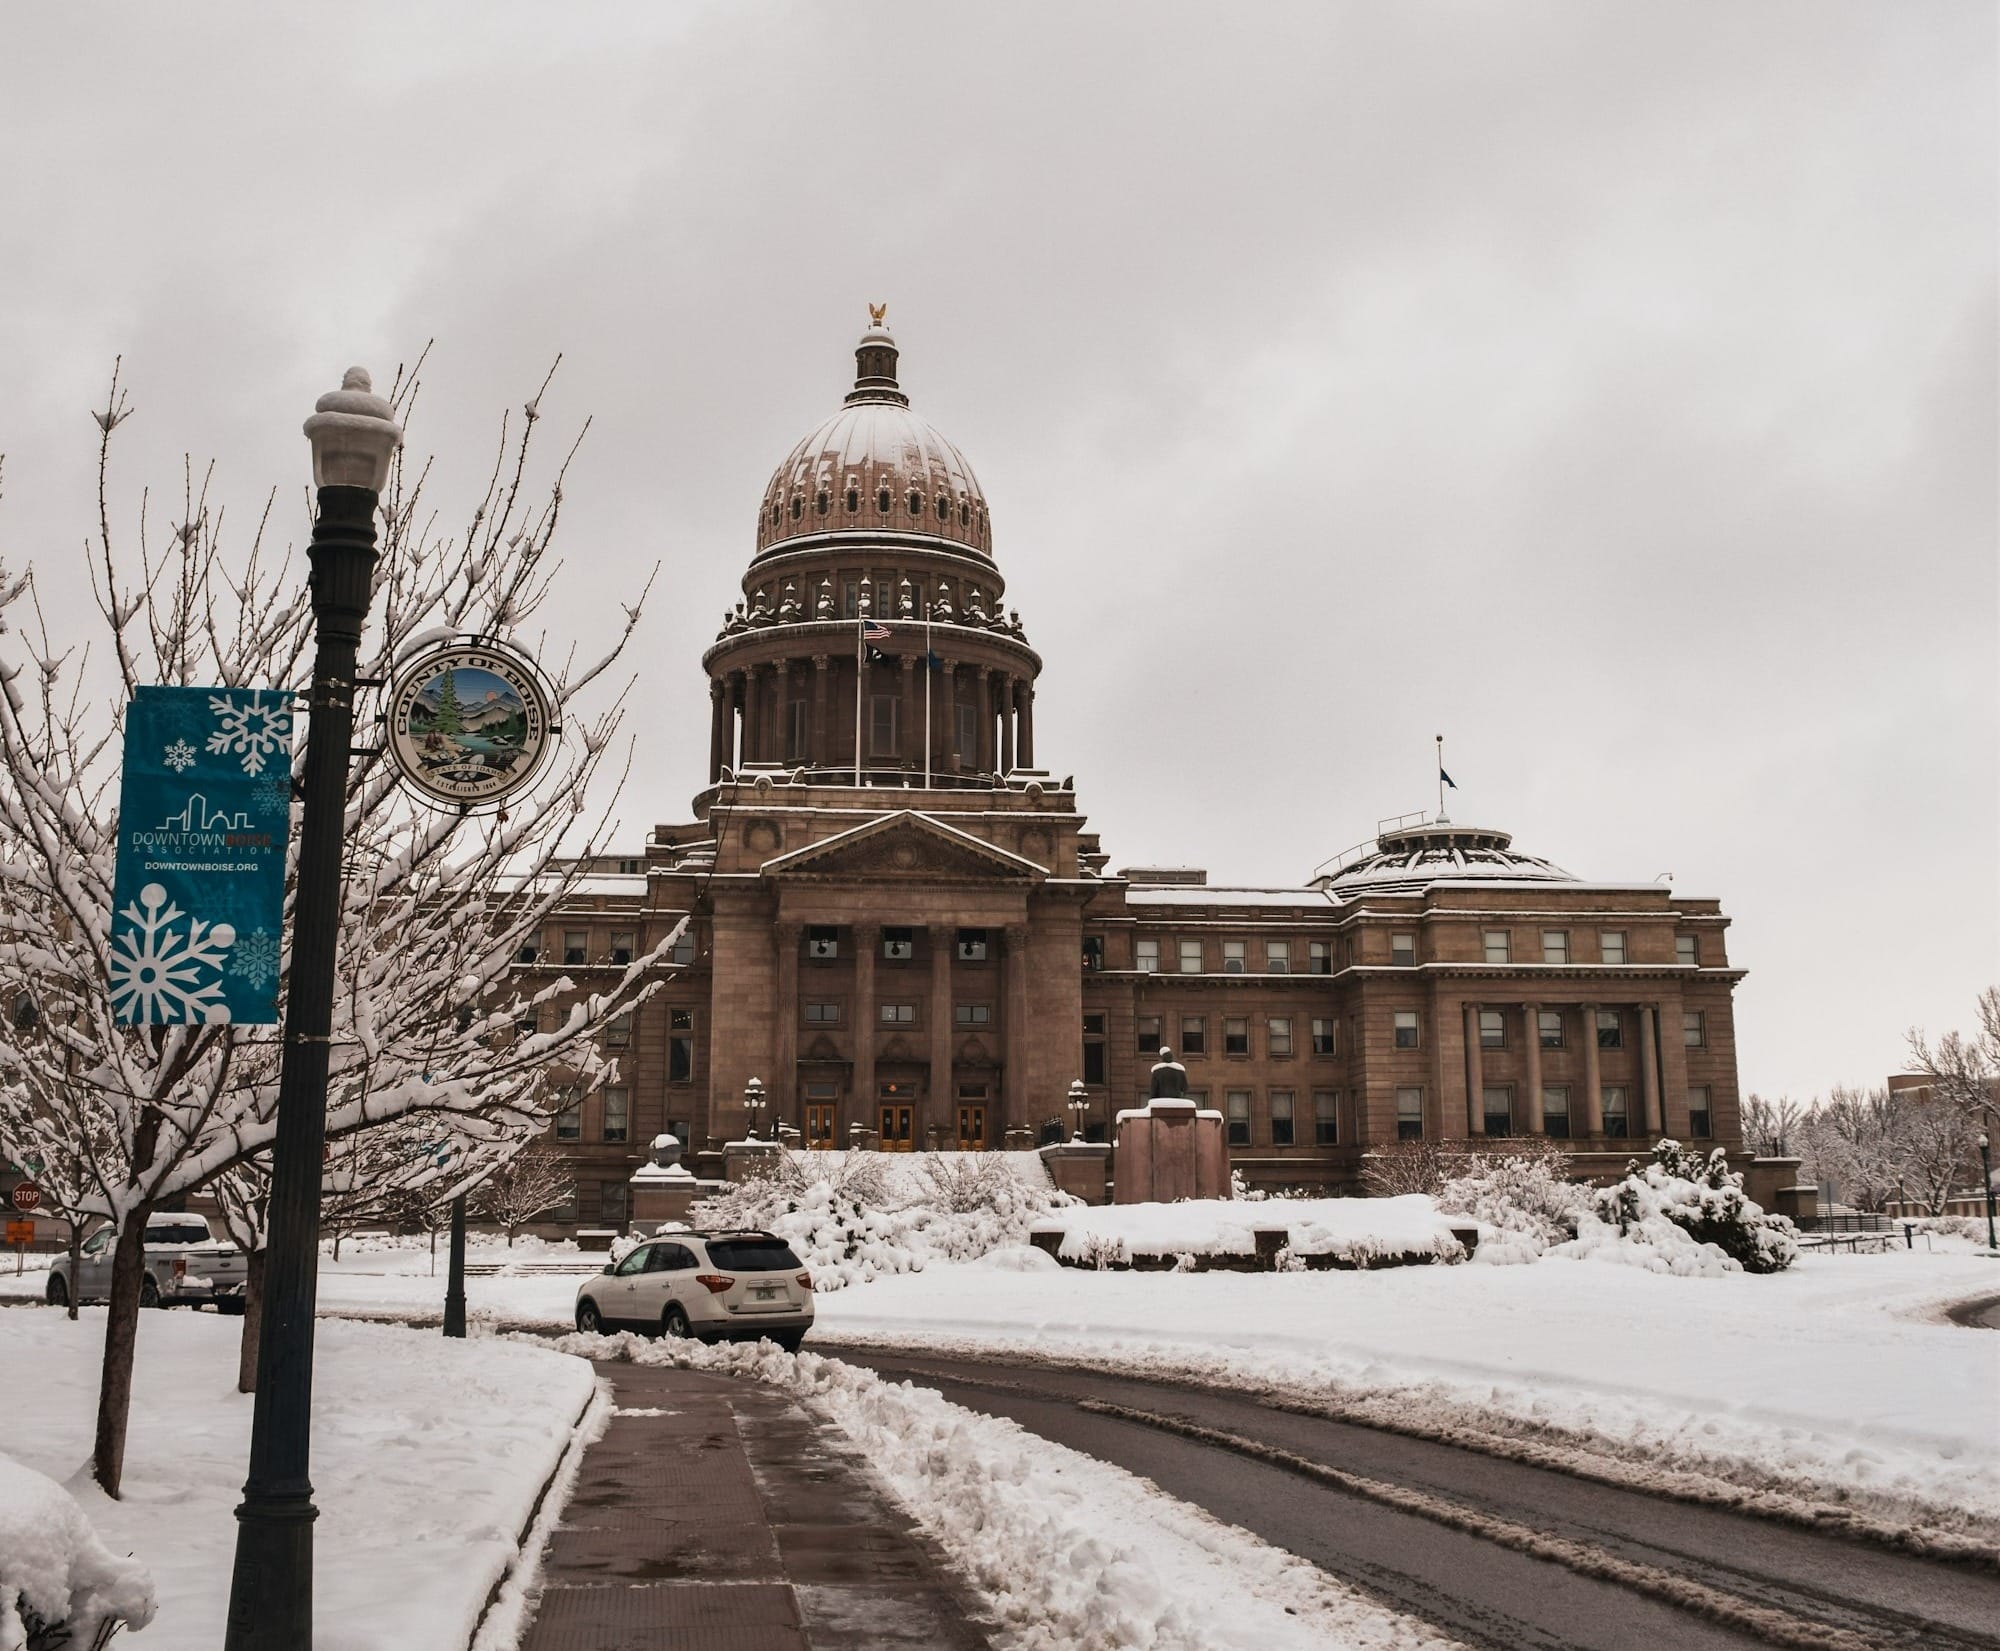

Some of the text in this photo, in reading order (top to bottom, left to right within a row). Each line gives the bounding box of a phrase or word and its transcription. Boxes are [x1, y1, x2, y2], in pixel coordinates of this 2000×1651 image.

[398, 657, 539, 741] COUNTY OF BOISE
[430, 765, 457, 775] STATE
[475, 764, 503, 777] IDAHO
[133, 845, 272, 855] ASSOCIATION
[144, 861, 259, 872] DOWNTOWNBOISE.ORG
[15, 1191, 39, 1202] STOP
